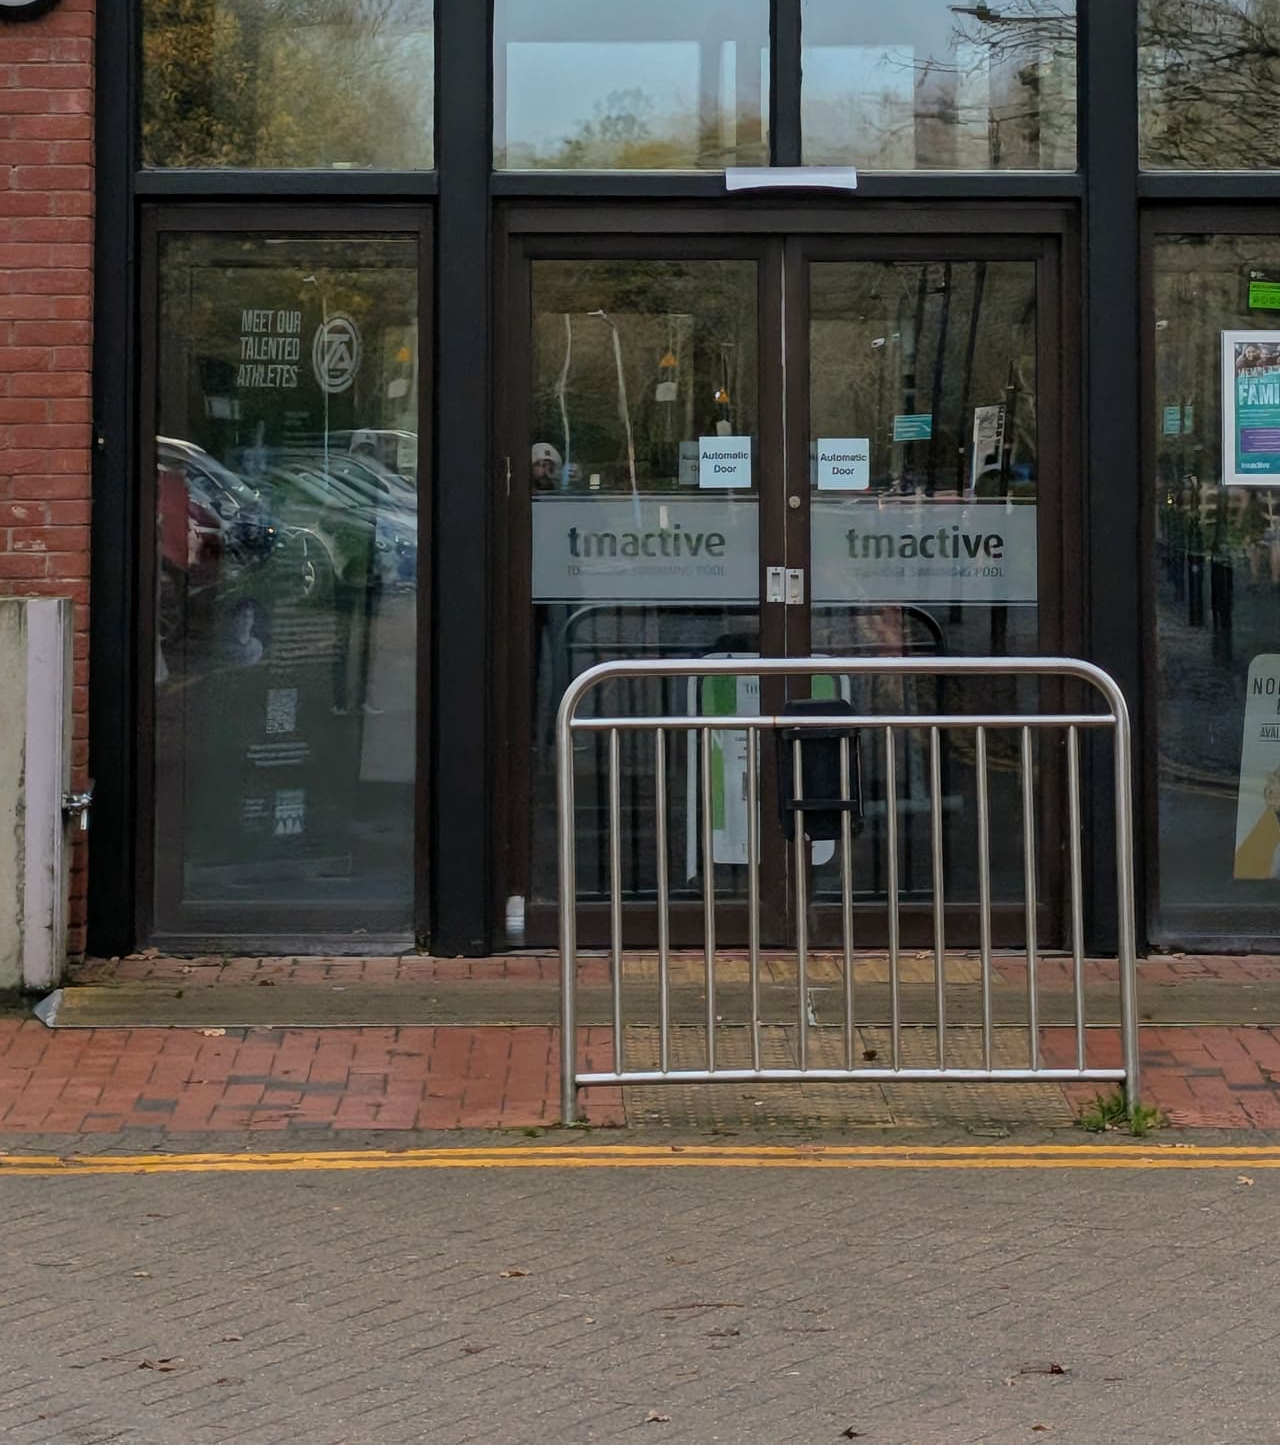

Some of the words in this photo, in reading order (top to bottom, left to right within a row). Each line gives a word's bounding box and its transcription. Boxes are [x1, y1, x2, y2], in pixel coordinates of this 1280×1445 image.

[241, 309, 274, 333] MEET
[276, 309, 302, 333] OUR
[239, 336, 301, 360] TALENTED
[236, 364, 300, 387] ATHLETES
[702, 450, 749, 461] Automatic
[820, 452, 868, 463] Automatic
[713, 464, 737, 474] Door
[831, 465, 855, 476] Door
[568, 524, 726, 558] tmactive
[845, 525, 1005, 559] tmactive
